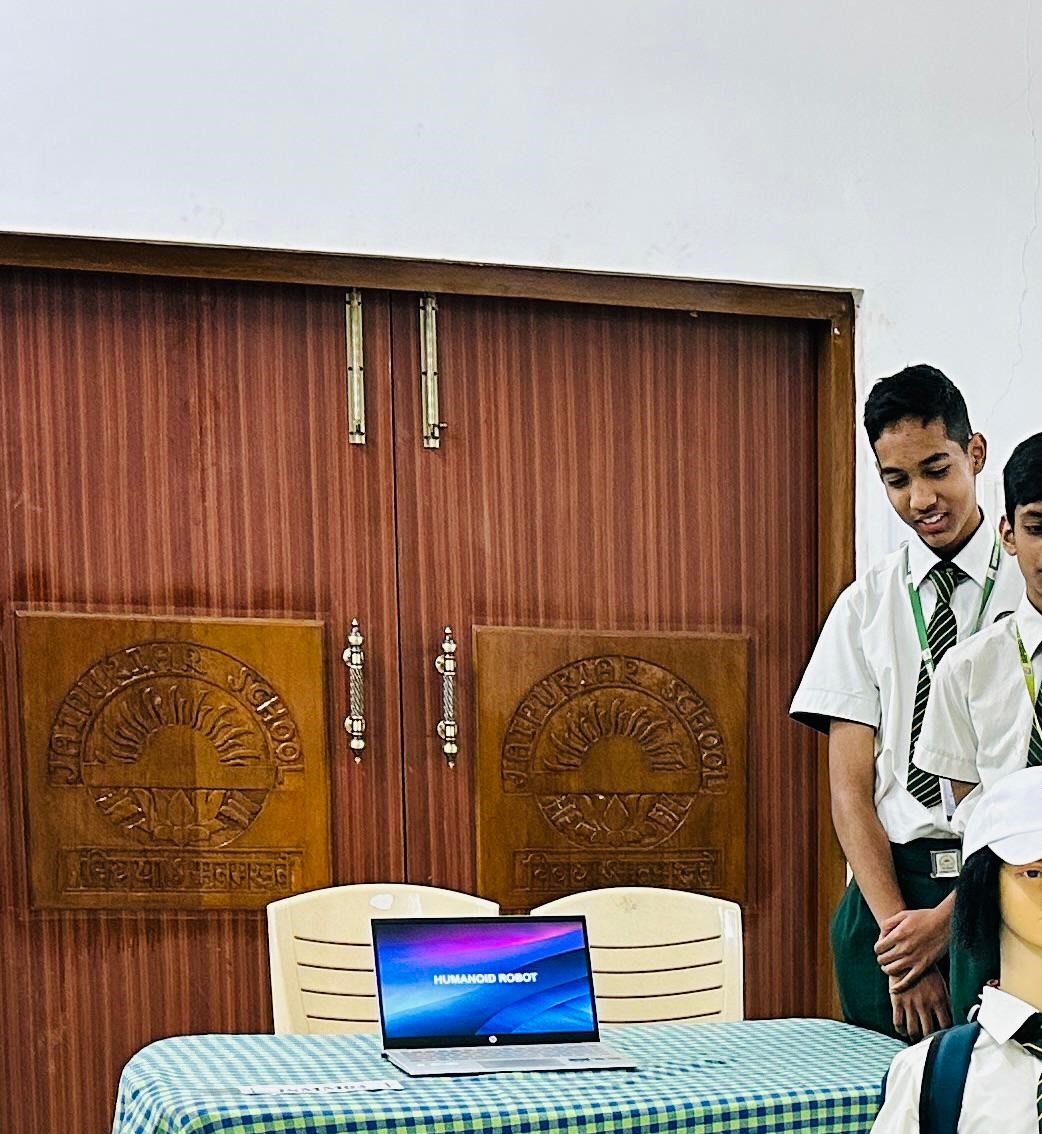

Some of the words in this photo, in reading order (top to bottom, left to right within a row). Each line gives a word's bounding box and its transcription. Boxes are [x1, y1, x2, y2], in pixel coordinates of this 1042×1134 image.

[227, 666, 304, 785] SCHOOL
[661, 679, 728, 794] SCHOOL
[433, 973, 497, 985] HUMANOID
[498, 972, 538, 984] ROBOT
